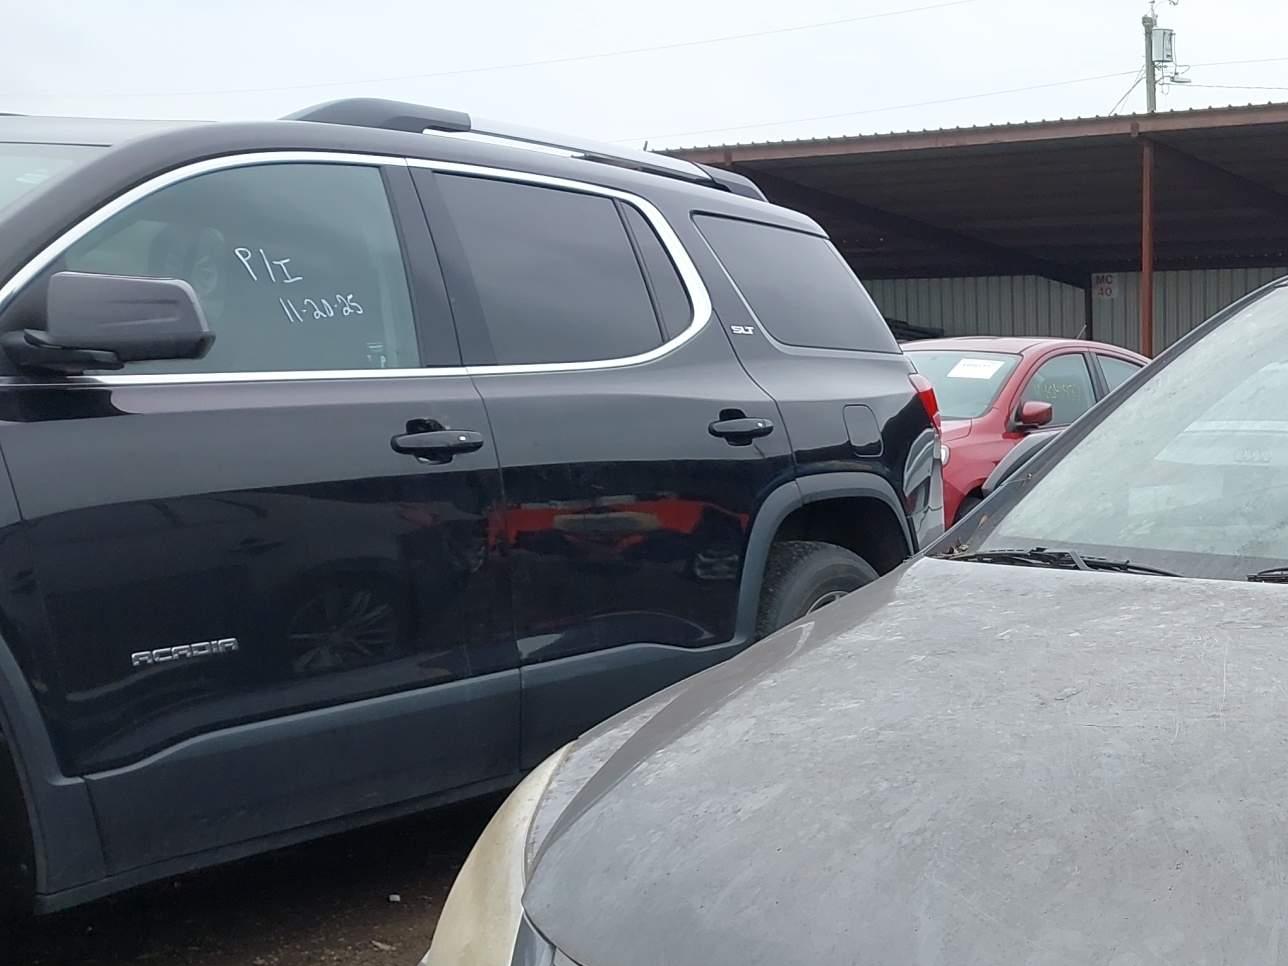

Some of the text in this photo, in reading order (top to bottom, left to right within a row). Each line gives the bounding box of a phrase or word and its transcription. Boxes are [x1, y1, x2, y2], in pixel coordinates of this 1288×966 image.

[1096, 274, 1113, 285] MC
[731, 325, 755, 335] SLT
[131, 637, 239, 666] ACADIA
